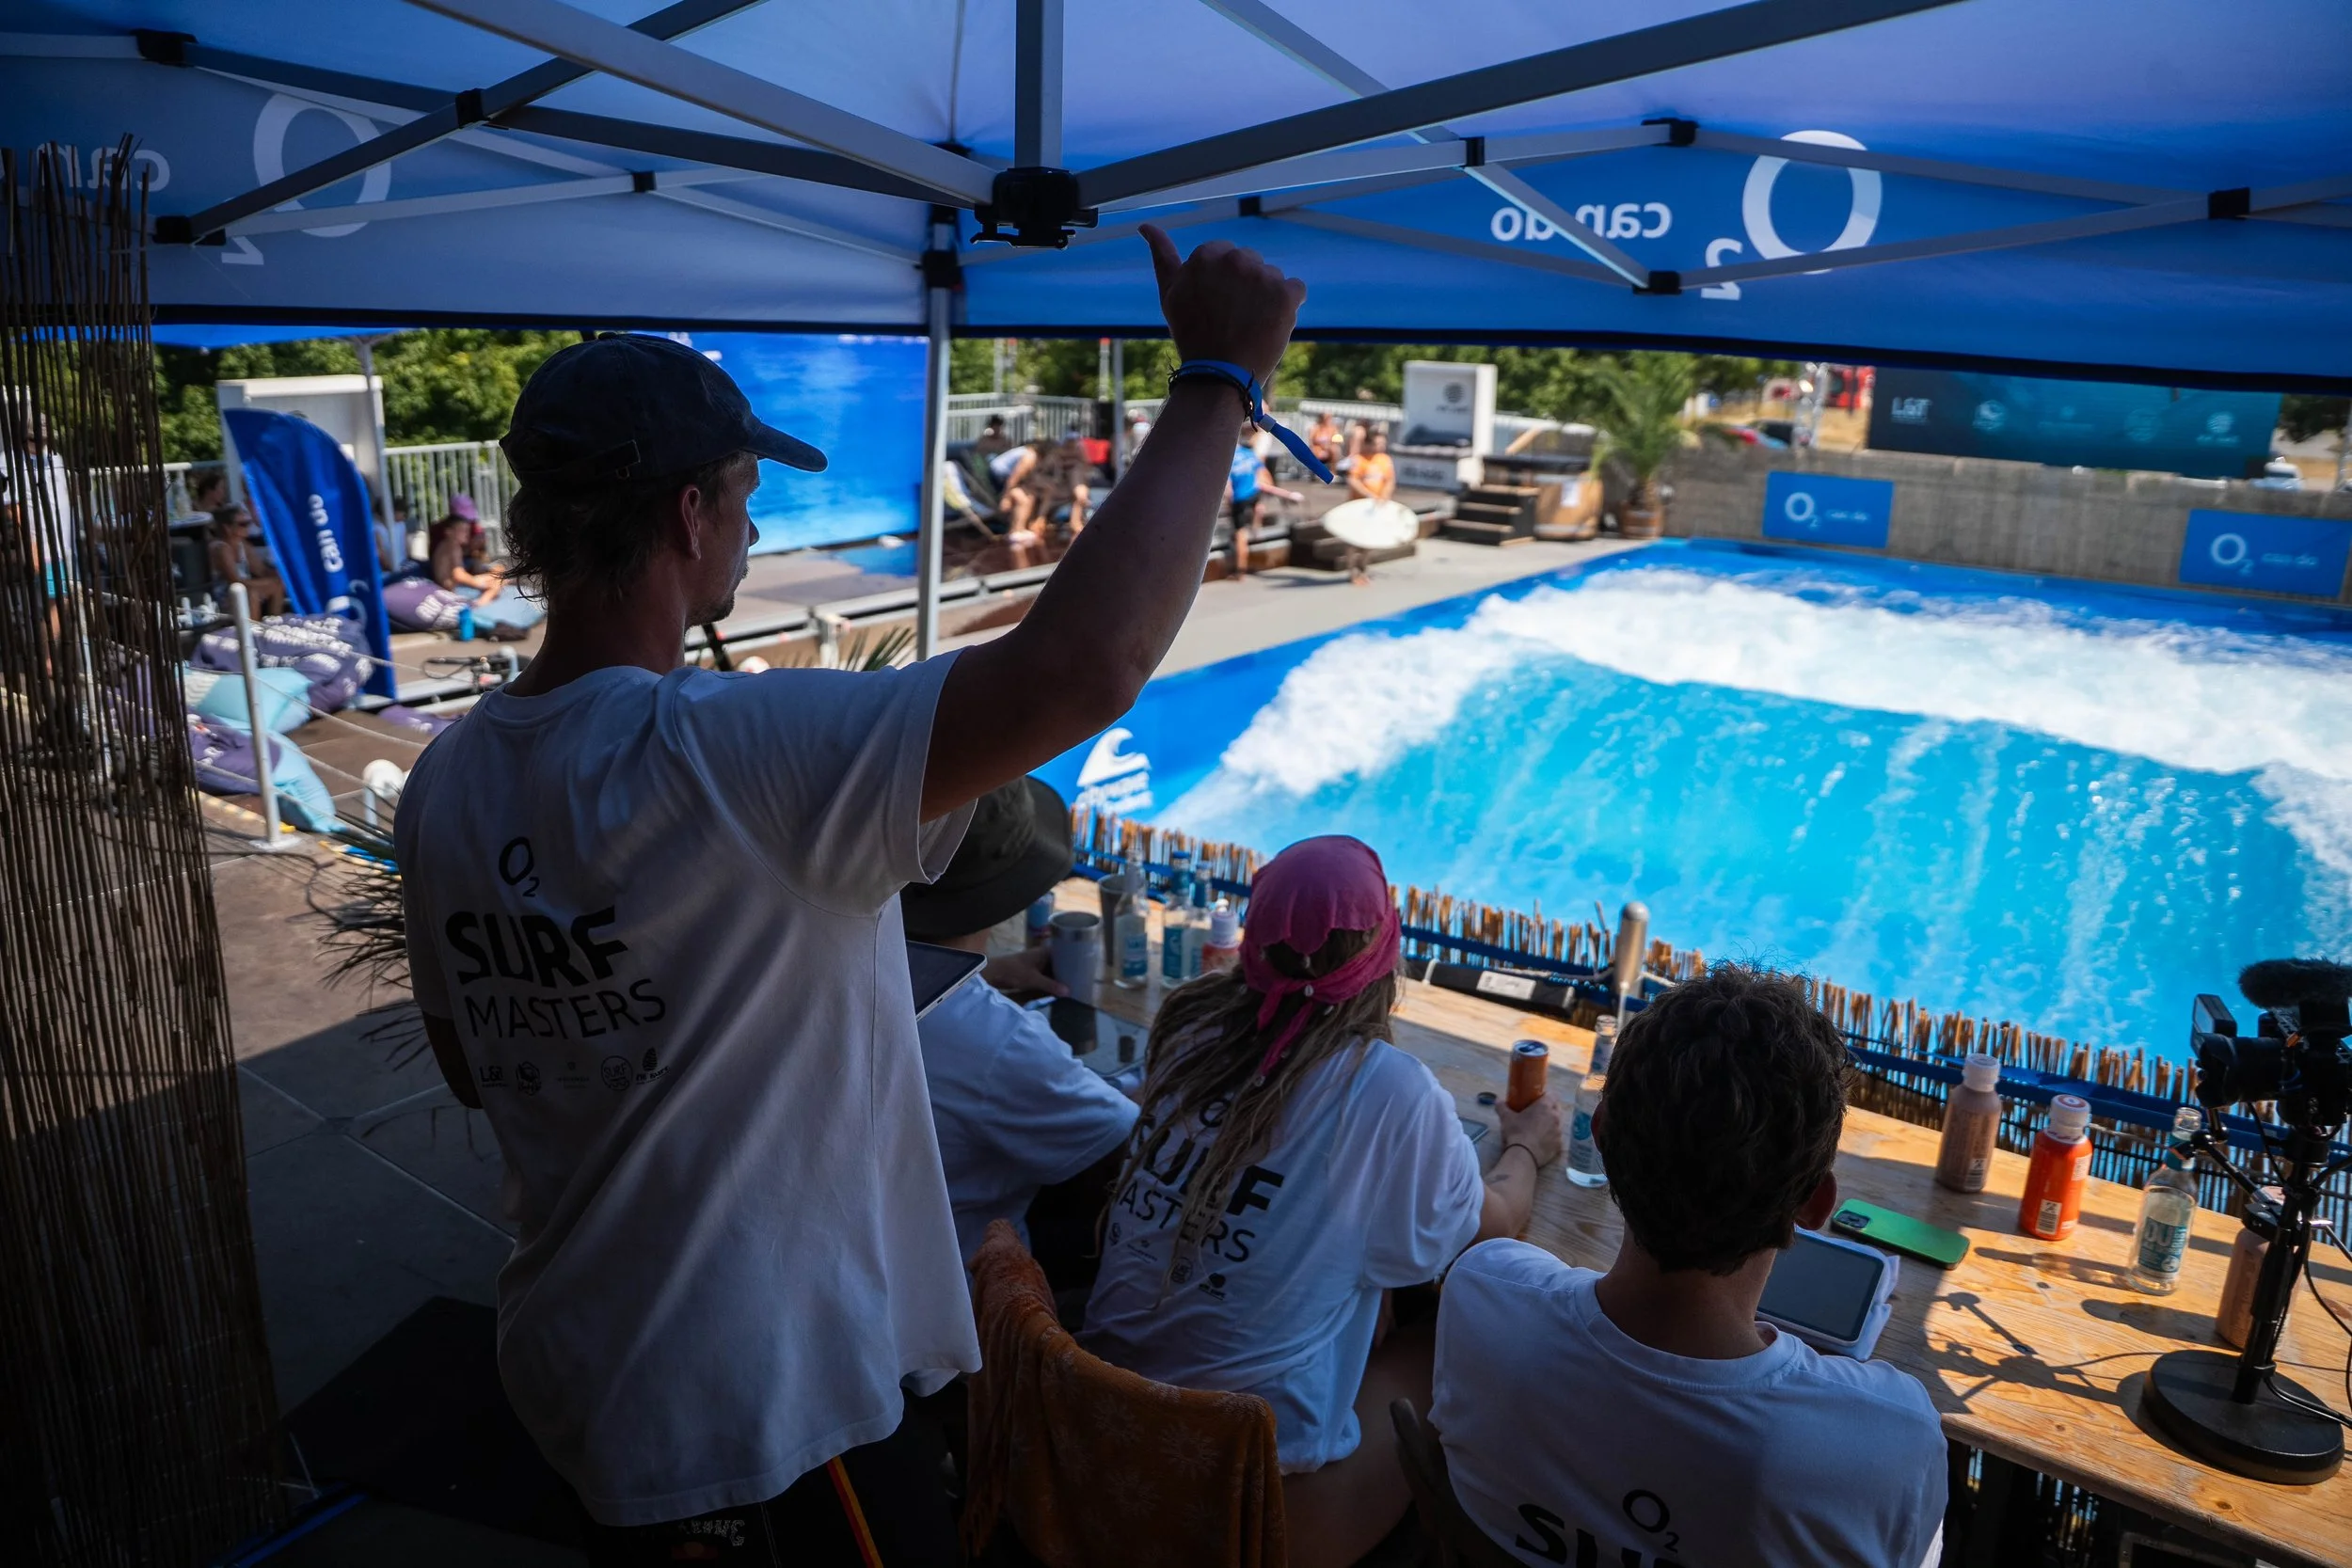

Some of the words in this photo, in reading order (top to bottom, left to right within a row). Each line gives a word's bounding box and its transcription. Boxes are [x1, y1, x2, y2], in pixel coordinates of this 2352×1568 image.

[2211, 532, 2255, 578] O2
[498, 836, 540, 897] O2
[445, 905, 628, 988] SURF
[465, 978, 665, 1040] MASTERS
[1622, 1489, 1679, 1553] O2
